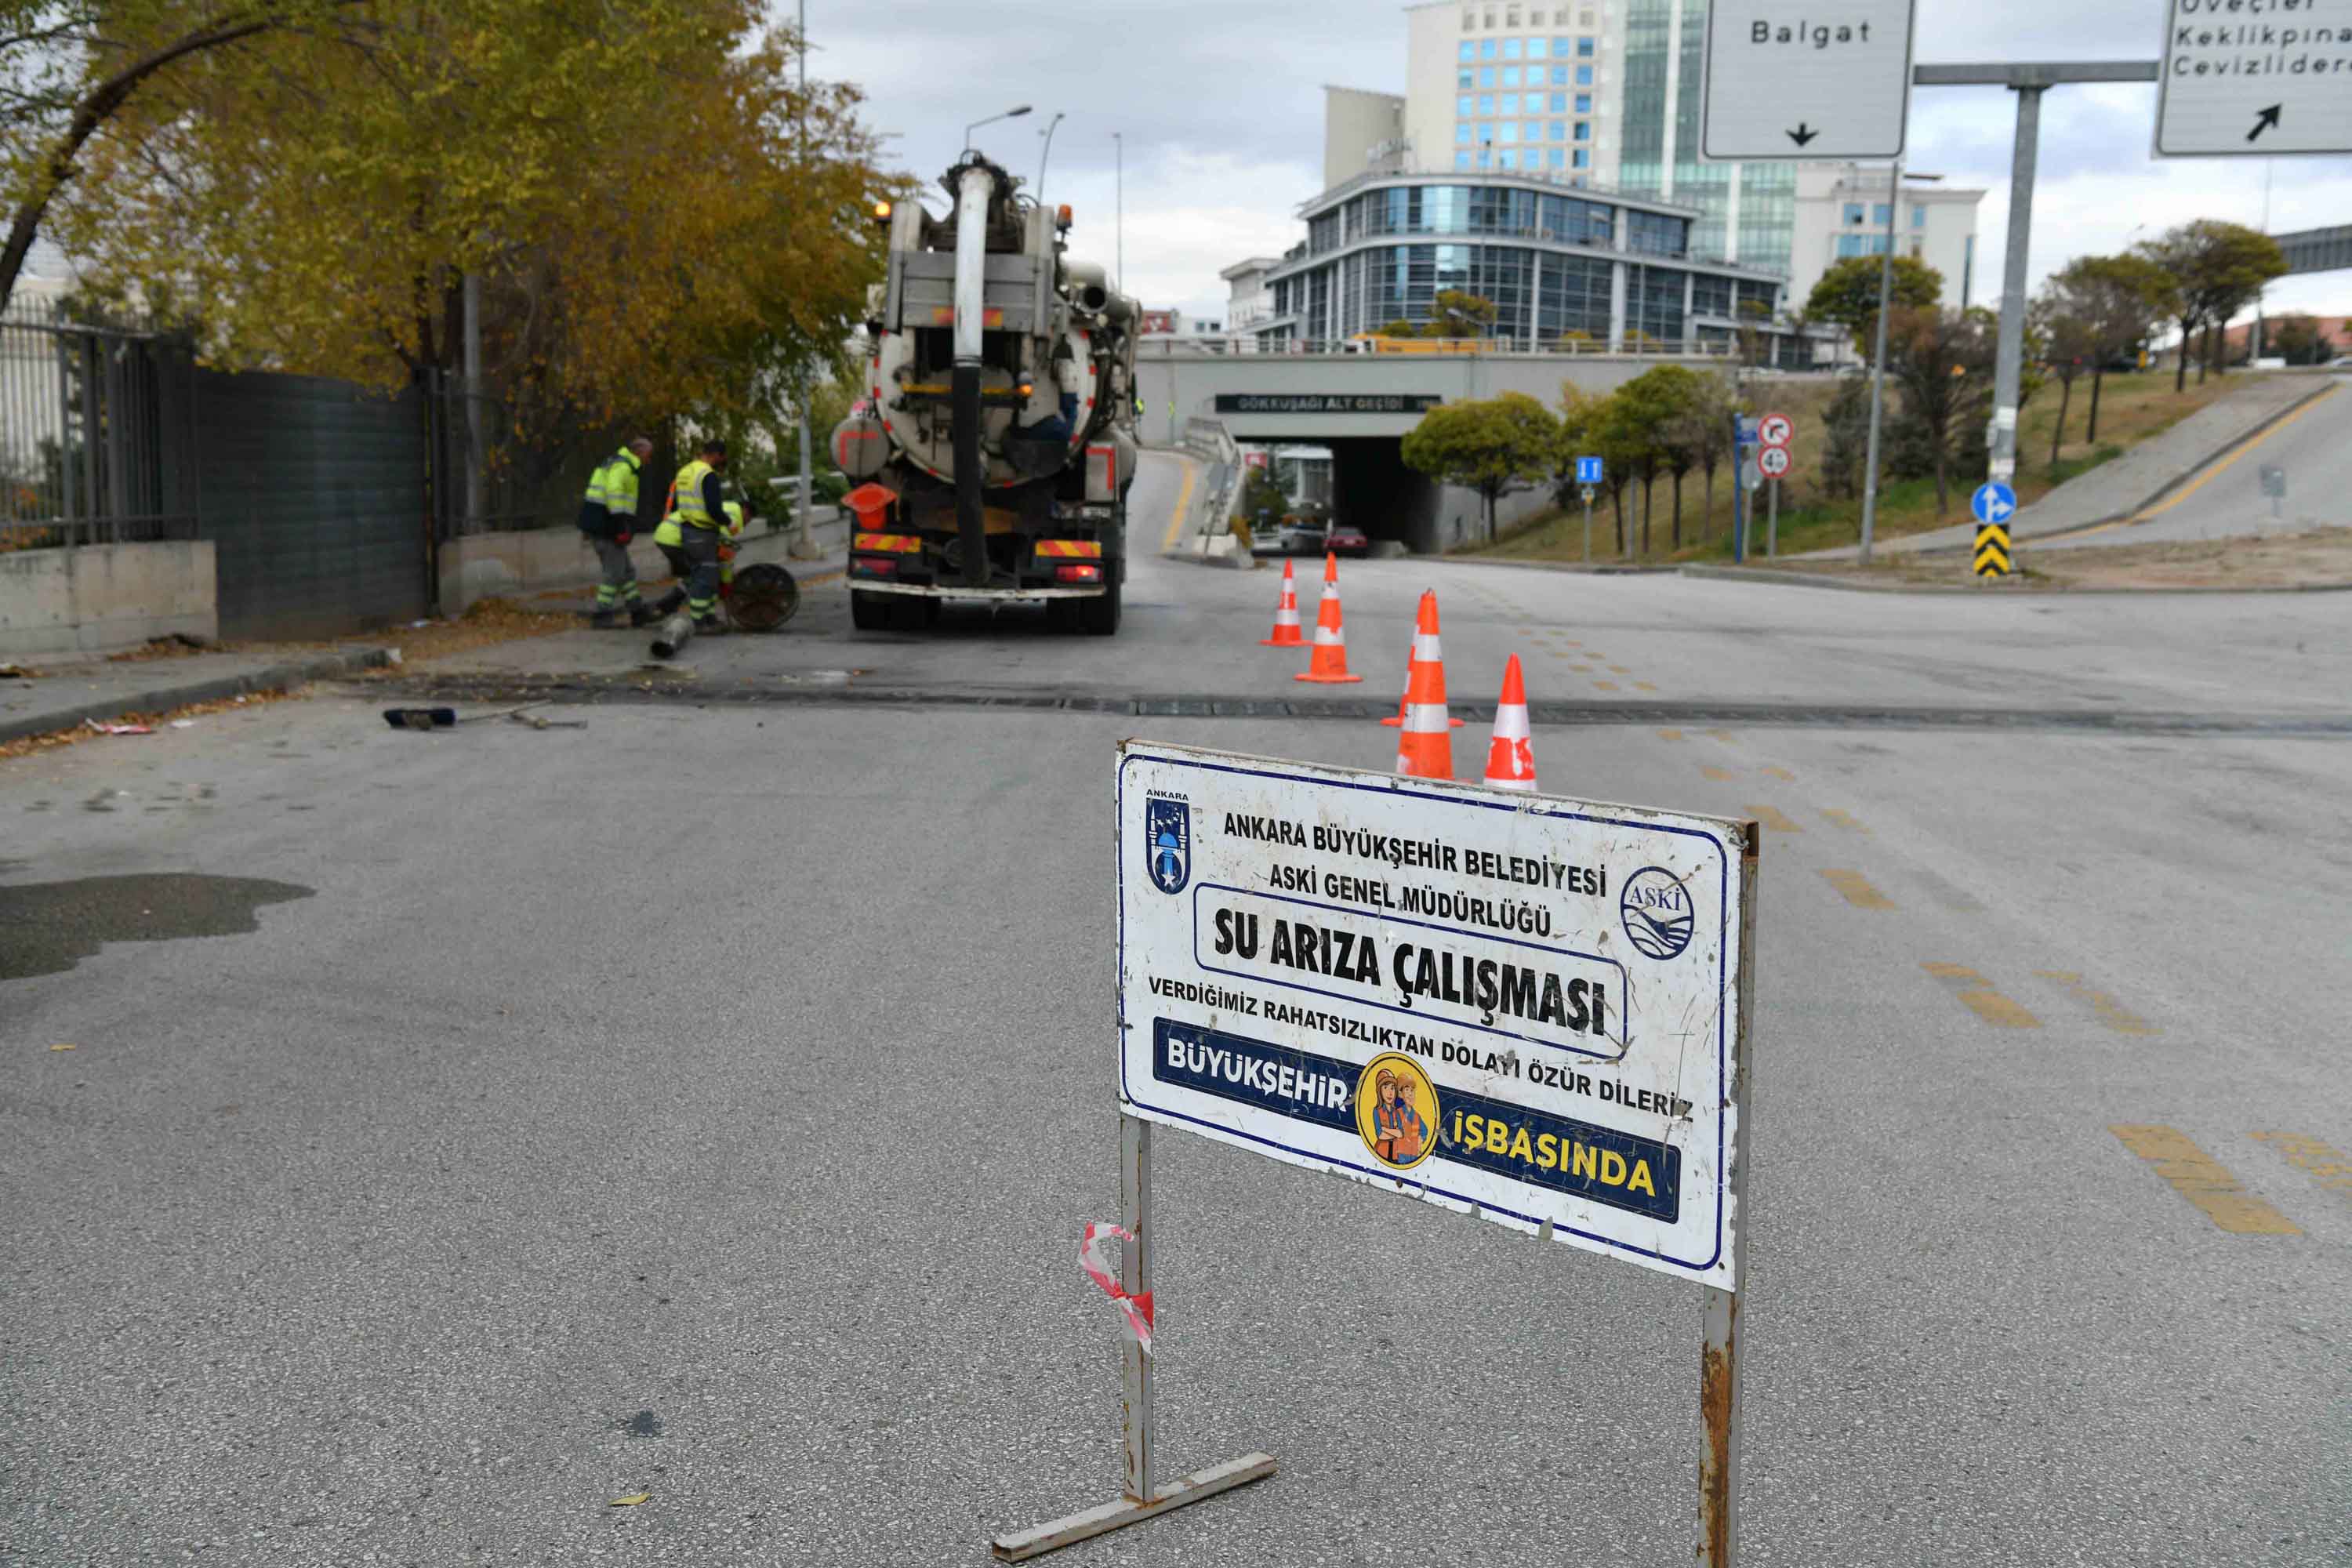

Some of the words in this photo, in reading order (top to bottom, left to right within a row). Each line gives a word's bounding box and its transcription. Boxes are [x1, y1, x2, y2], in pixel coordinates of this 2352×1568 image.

[1751, 20, 1871, 49] Balgat
[2173, 53, 2352, 76] Cevizlider
[1327, 397, 1352, 410] ALT
[1146, 789, 1189, 801] ANKARA
[1225, 812, 1307, 848] ANKARA
[1313, 822, 1458, 873] BÜYÜKŞEHİR
[1465, 849, 1606, 898] BELEDİYESİ
[1269, 863, 1317, 895] ASKİ
[1324, 873, 1396, 909] GENEL
[1403, 884, 1551, 938] MÜDÜRLÜĞÜ
[1629, 885, 1681, 911] ASKİ
[1215, 908, 1258, 960] SU
[1270, 919, 1381, 986] ARIZA
[1393, 943, 1605, 1036] ÇALIŞMASI
[1149, 976, 1258, 1016] VERDİĞİMİZ
[1264, 1000, 1434, 1058] RAHATSIZLIKTAN
[1441, 1041, 1520, 1079] DOLAYI
[1528, 1058, 1592, 1097] ÖZÜR
[1599, 1078, 1693, 1123] DİLERİZ
[1168, 1037, 1349, 1112] BÜYÜKŞEHİR
